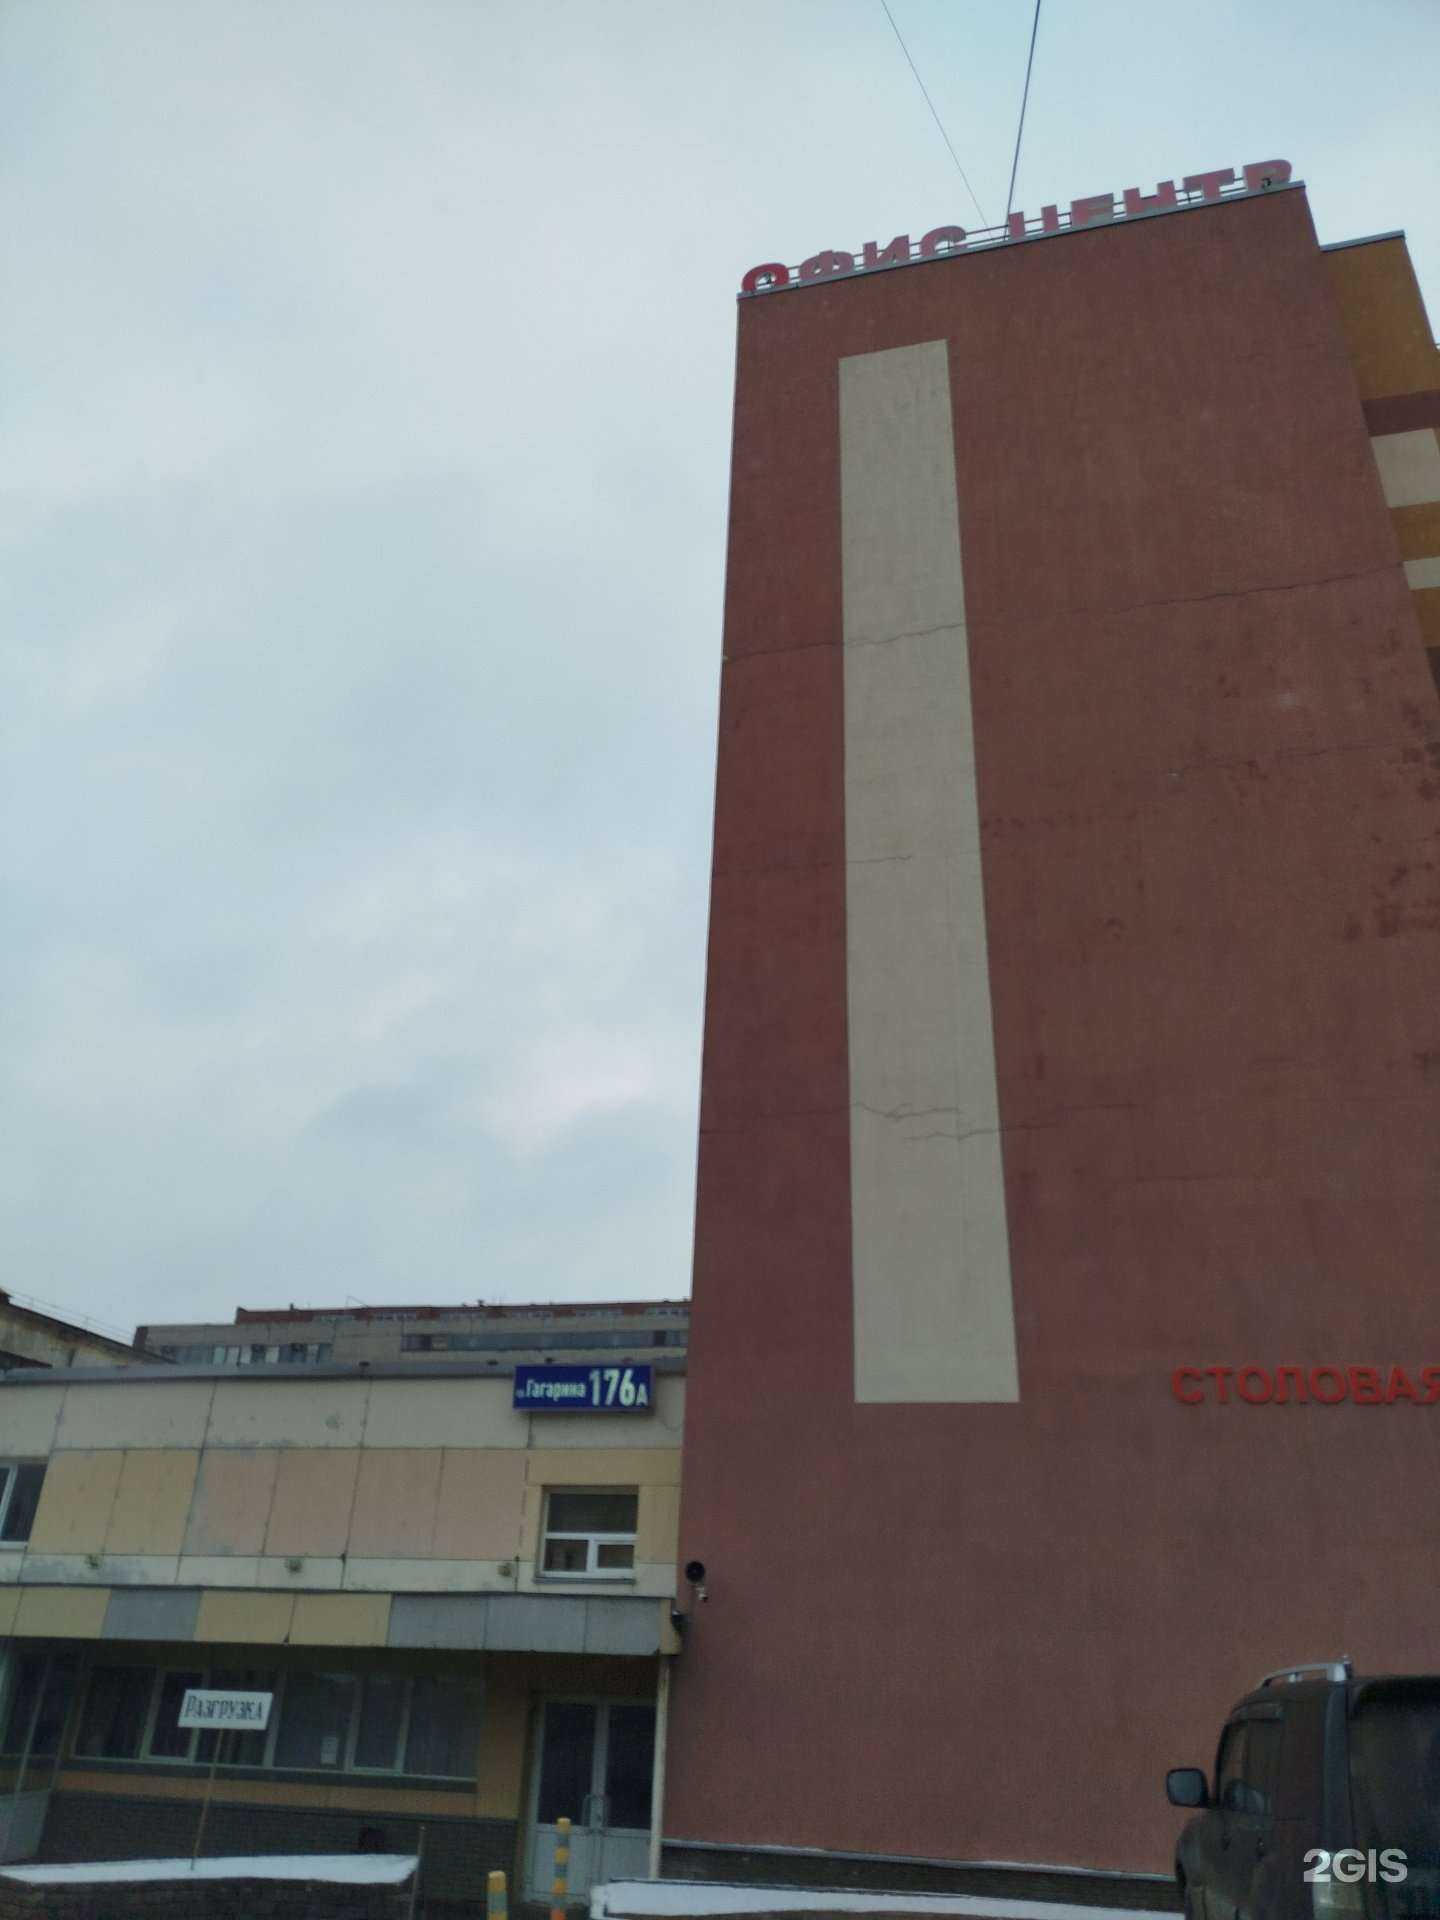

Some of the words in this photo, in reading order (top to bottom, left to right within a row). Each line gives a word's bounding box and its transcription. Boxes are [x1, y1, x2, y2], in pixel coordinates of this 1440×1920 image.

[741, 225, 967, 292] ОФИС
[1008, 158, 1293, 239] ЦЕНТР
[526, 1379, 587, 1402] Гагарина
[1171, 1366, 1440, 1404] СТОЛОВАЯ
